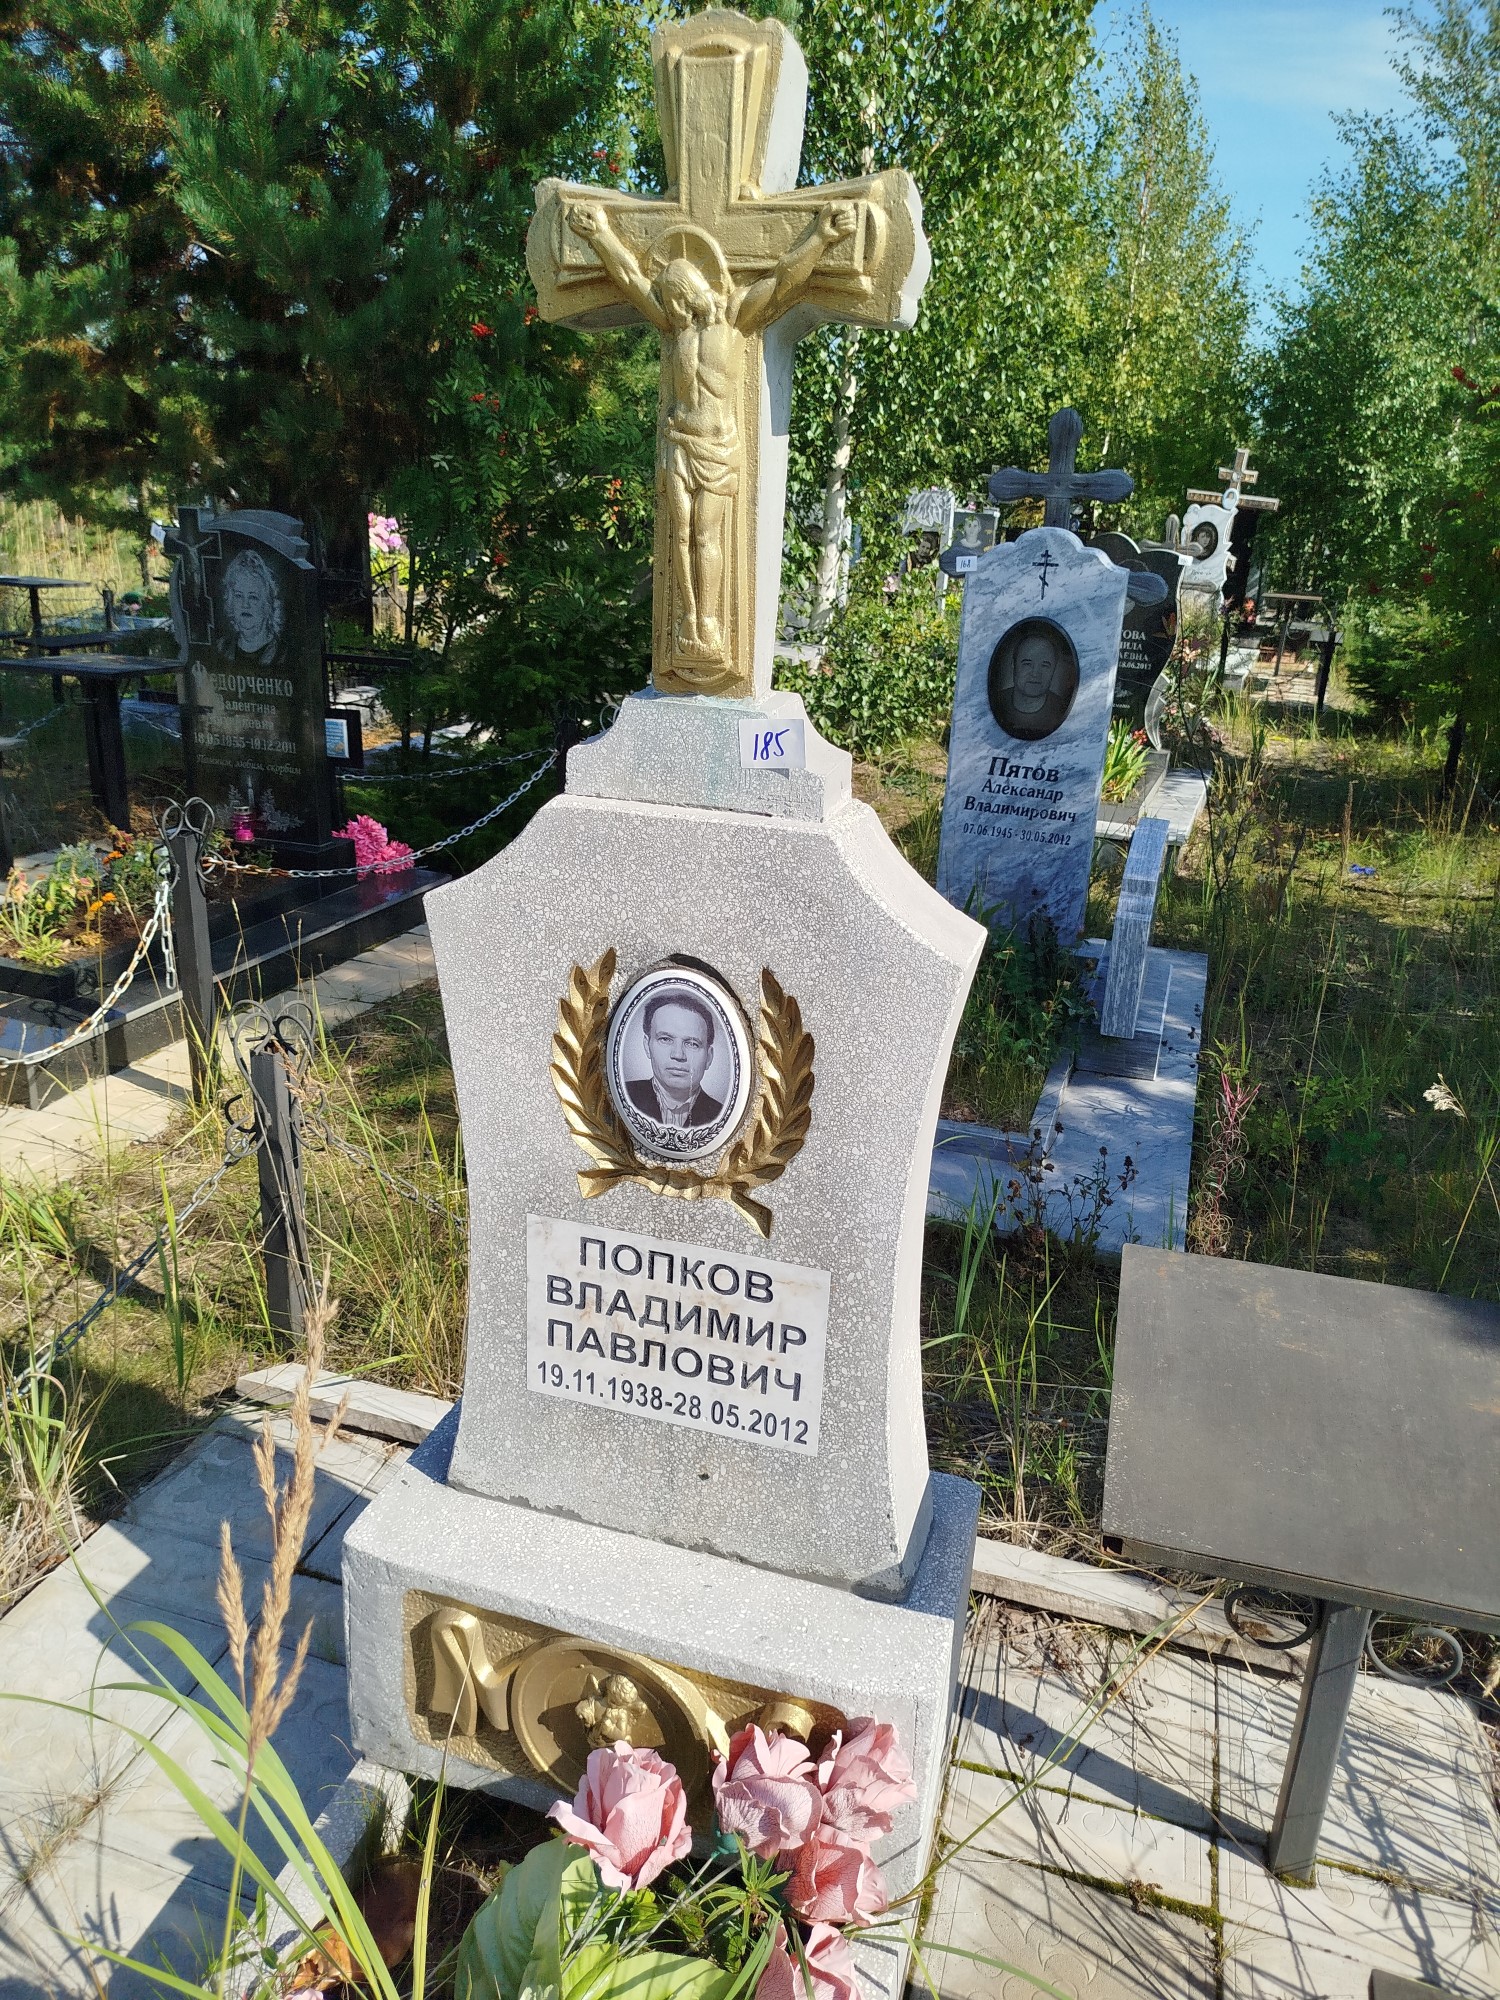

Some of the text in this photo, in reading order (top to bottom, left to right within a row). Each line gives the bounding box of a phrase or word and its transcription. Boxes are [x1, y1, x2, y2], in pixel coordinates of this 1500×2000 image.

[960, 559, 971, 569] 168
[1119, 641, 1143, 651] ИЛА
[1121, 629, 1146, 641] ОВА
[753, 728, 790, 760] 185
[987, 756, 1059, 783] Пятов
[981, 778, 1064, 804] Александр
[963, 795, 1077, 823] Владимирович
[963, 822, 1013, 839] 07.06.1945
[1019, 829, 1071, 846] 30.05.2012
[579, 1236, 774, 1304] ПОПКОВ
[546, 1274, 807, 1354] ВЛАДИМИР
[547, 1318, 802, 1402] ПАВЛОВИЧ
[537, 1360, 809, 1446] 19.11.1938-28.05.2012
